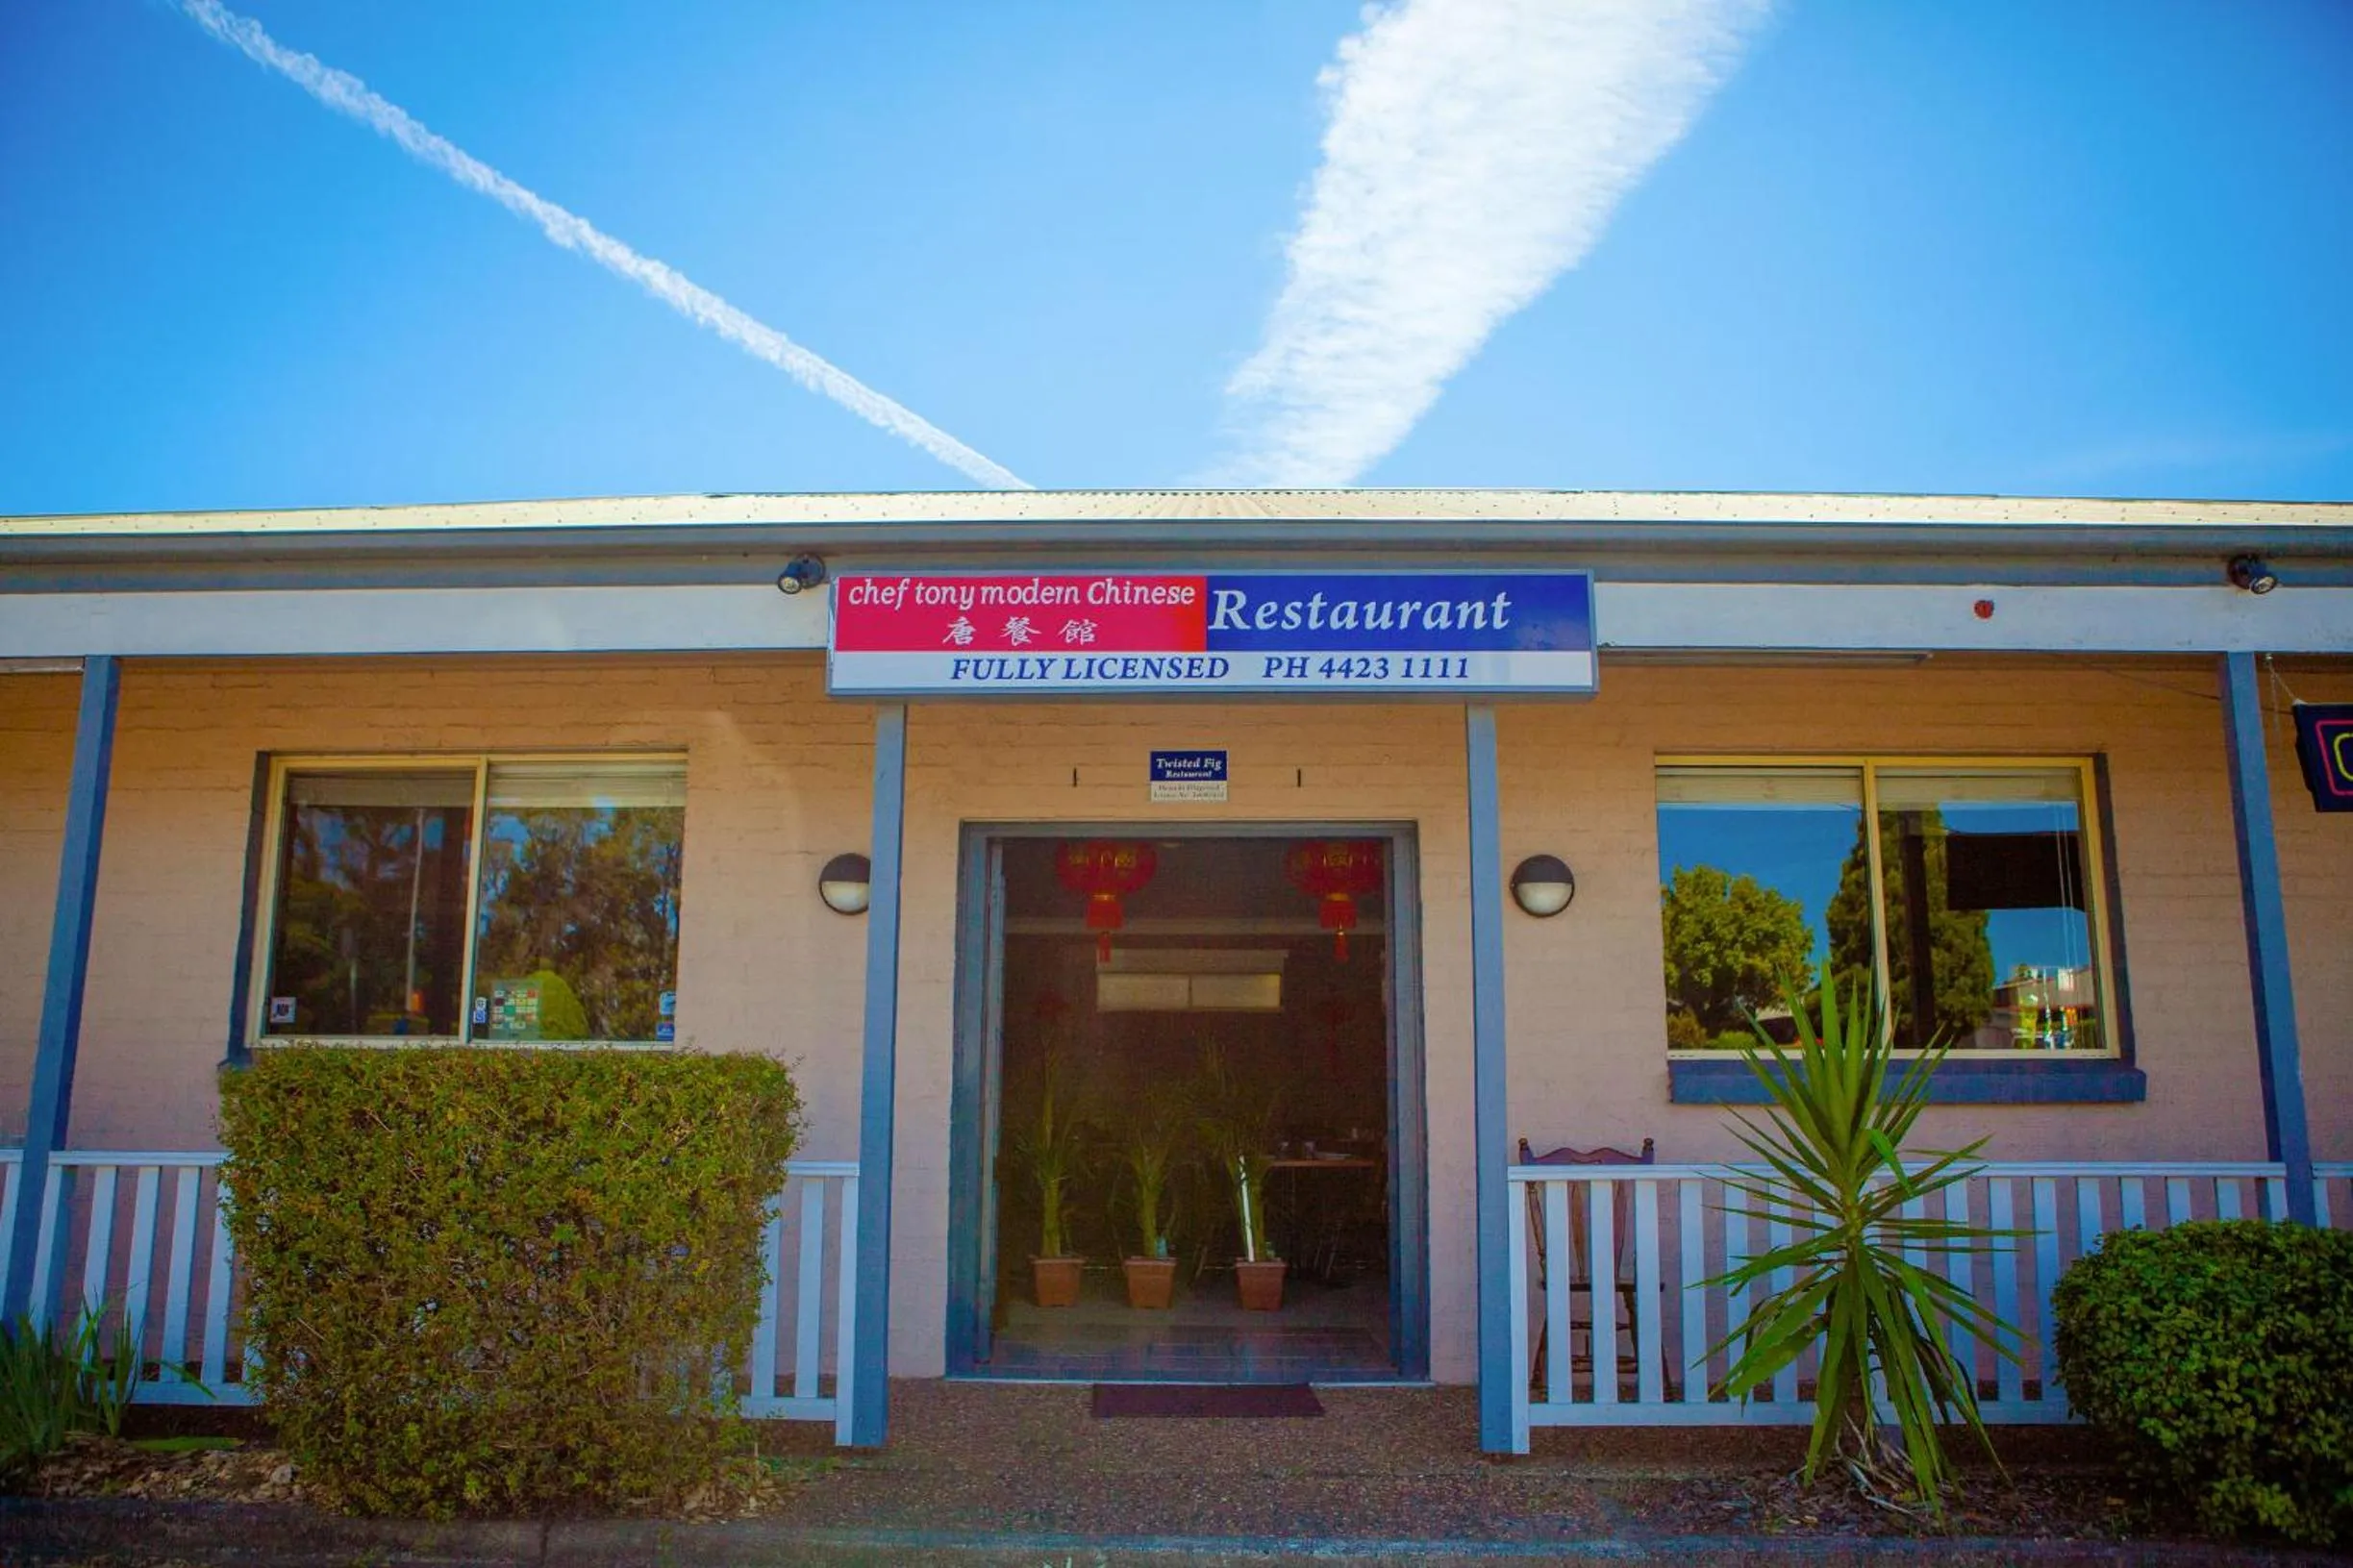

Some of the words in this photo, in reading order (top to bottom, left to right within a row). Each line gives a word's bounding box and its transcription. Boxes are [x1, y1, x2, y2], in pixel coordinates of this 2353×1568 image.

[848, 578, 910, 610] chef
[915, 582, 975, 610] tony
[981, 579, 1080, 605] modern
[1088, 579, 1195, 606] Chinese
[1208, 589, 1513, 631] Restaurant
[950, 658, 1057, 681] FULLY
[1062, 657, 1230, 680] LICENSED
[1262, 657, 1310, 679] PH
[1318, 657, 1389, 679] 4423
[1400, 657, 1470, 679] 1111
[1156, 758, 1201, 769] Twisted
[1203, 758, 1222, 771] Fig
